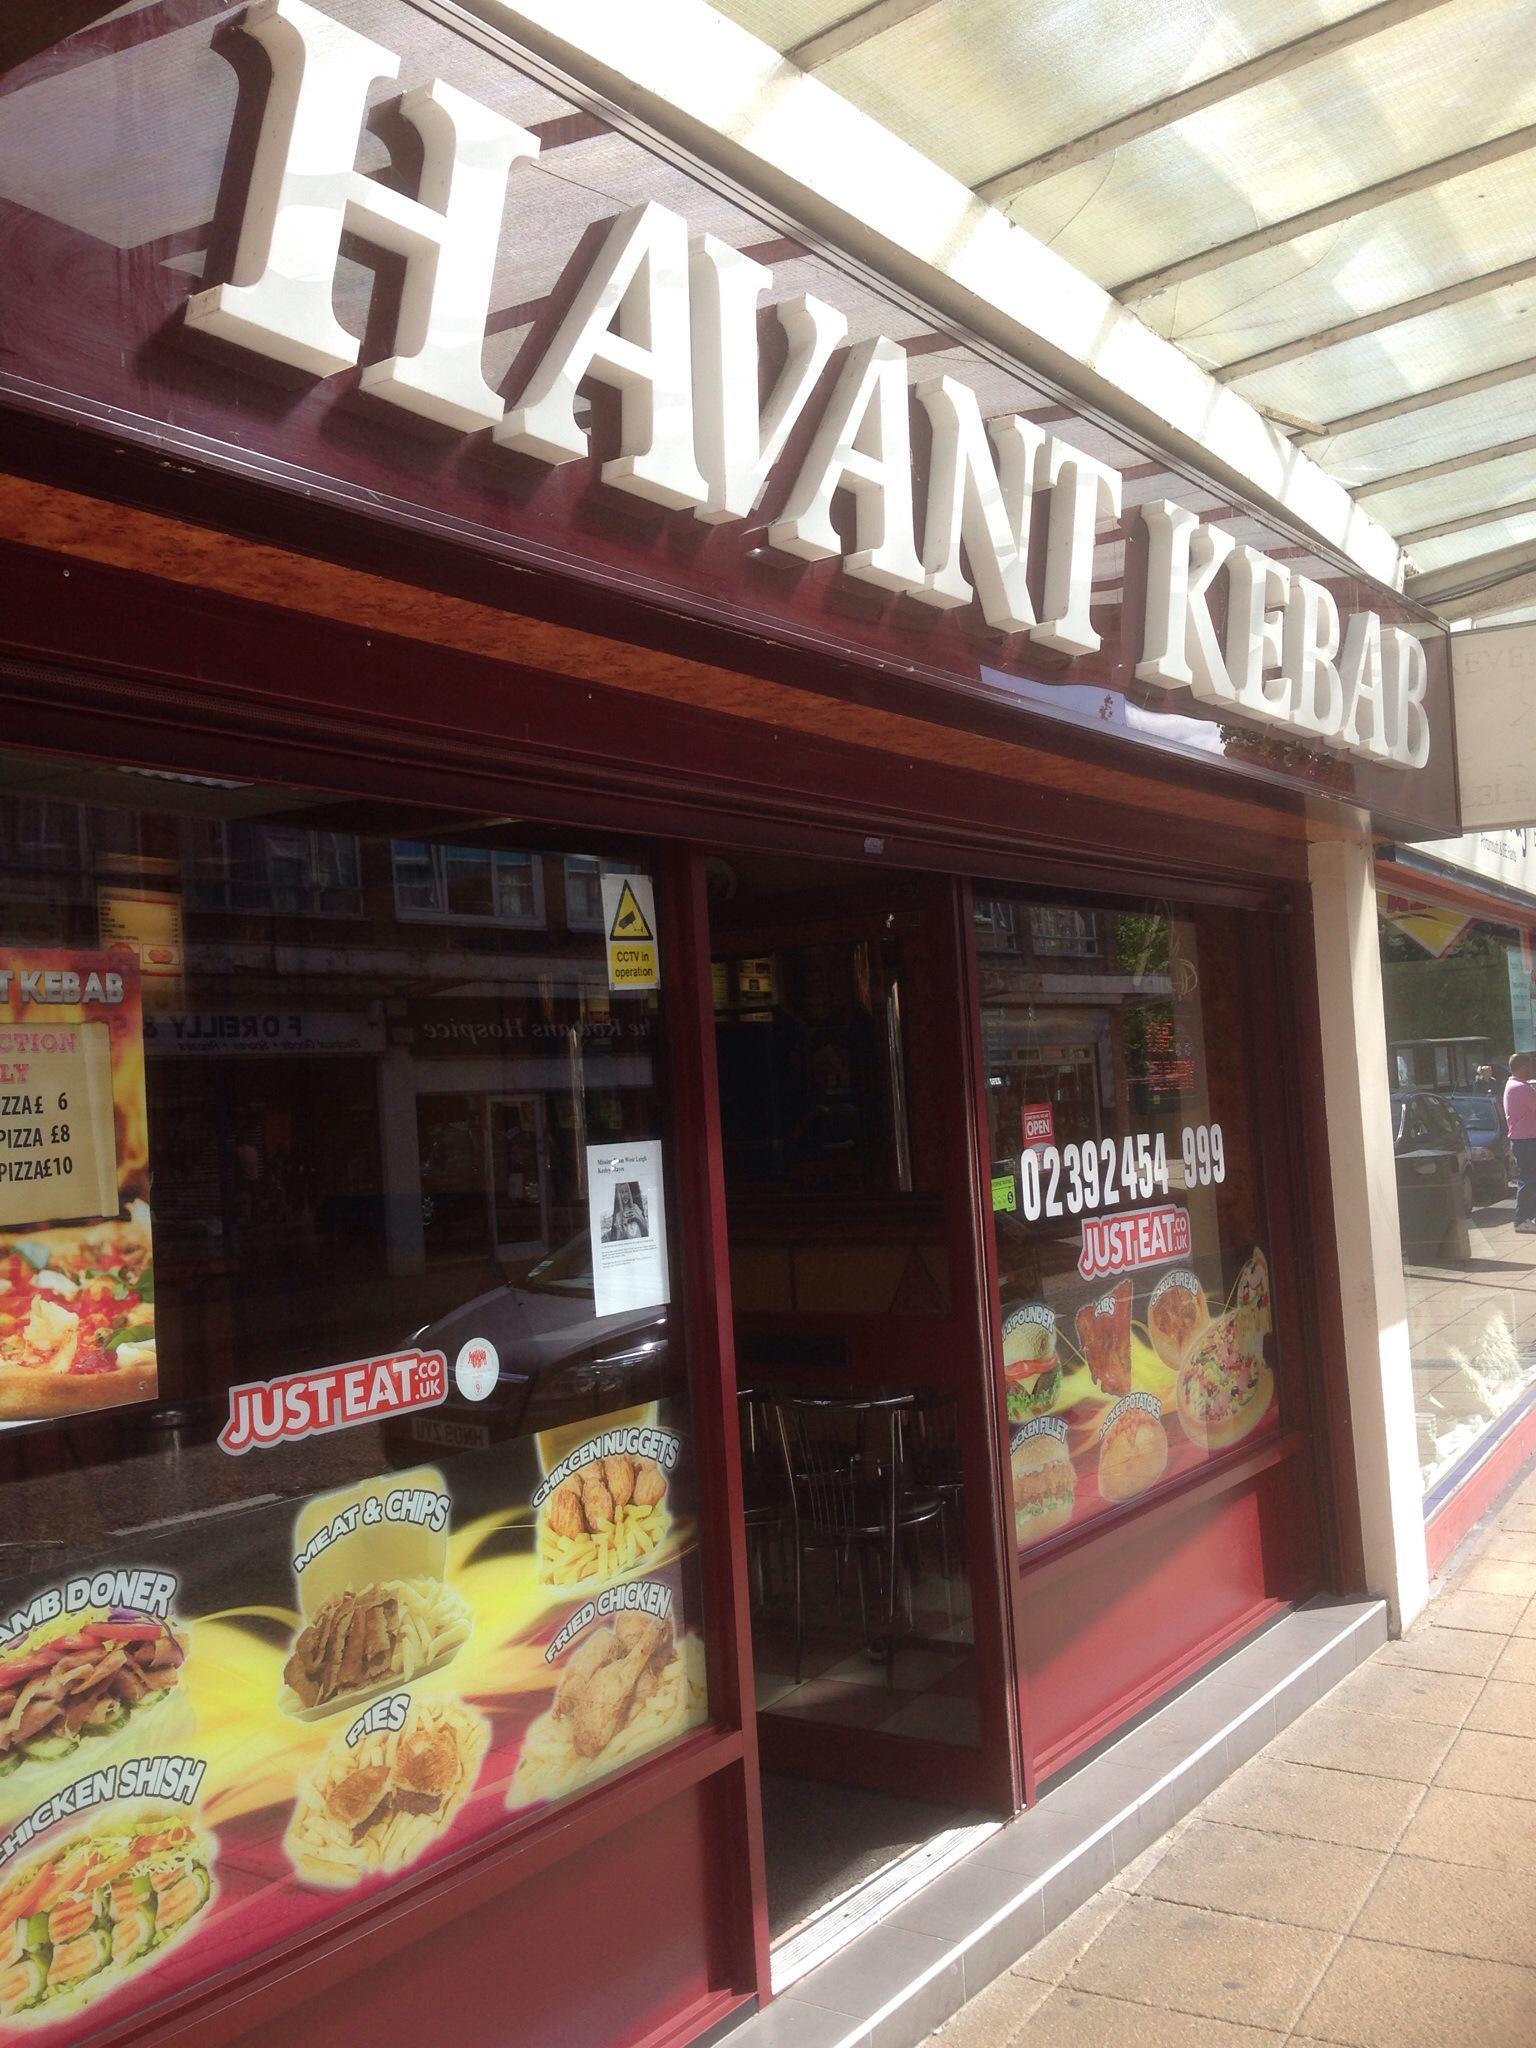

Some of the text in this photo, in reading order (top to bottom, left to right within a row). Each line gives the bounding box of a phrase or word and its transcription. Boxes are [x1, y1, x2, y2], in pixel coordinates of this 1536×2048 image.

[184, 0, 1430, 769] HAVANT KEBAB
[616, 952, 649, 962] CCTV in
[20, 969, 124, 1004] KEBAB
[615, 967, 653, 979] operation
[58, 1092, 68, 1110] 6
[51, 1124, 70, 1144] £8
[1026, 1119, 1050, 1136] OPEN
[1174, 1271, 1199, 1297] BREAD
[1011, 1304, 1056, 1334] POUNDER
[1125, 1392, 1162, 1421] POTATOES
[1042, 1415, 1069, 1444] FILLET
[532, 1428, 680, 1508] CHIKCEN NUGGETS
[294, 1489, 451, 1573] MEAT & CHIPS
[66, 1569, 177, 1619] DONER
[544, 1582, 672, 1664] FRIED CHICKEN
[345, 1694, 410, 1748] PIES
[118, 1756, 207, 1804] SHISH
